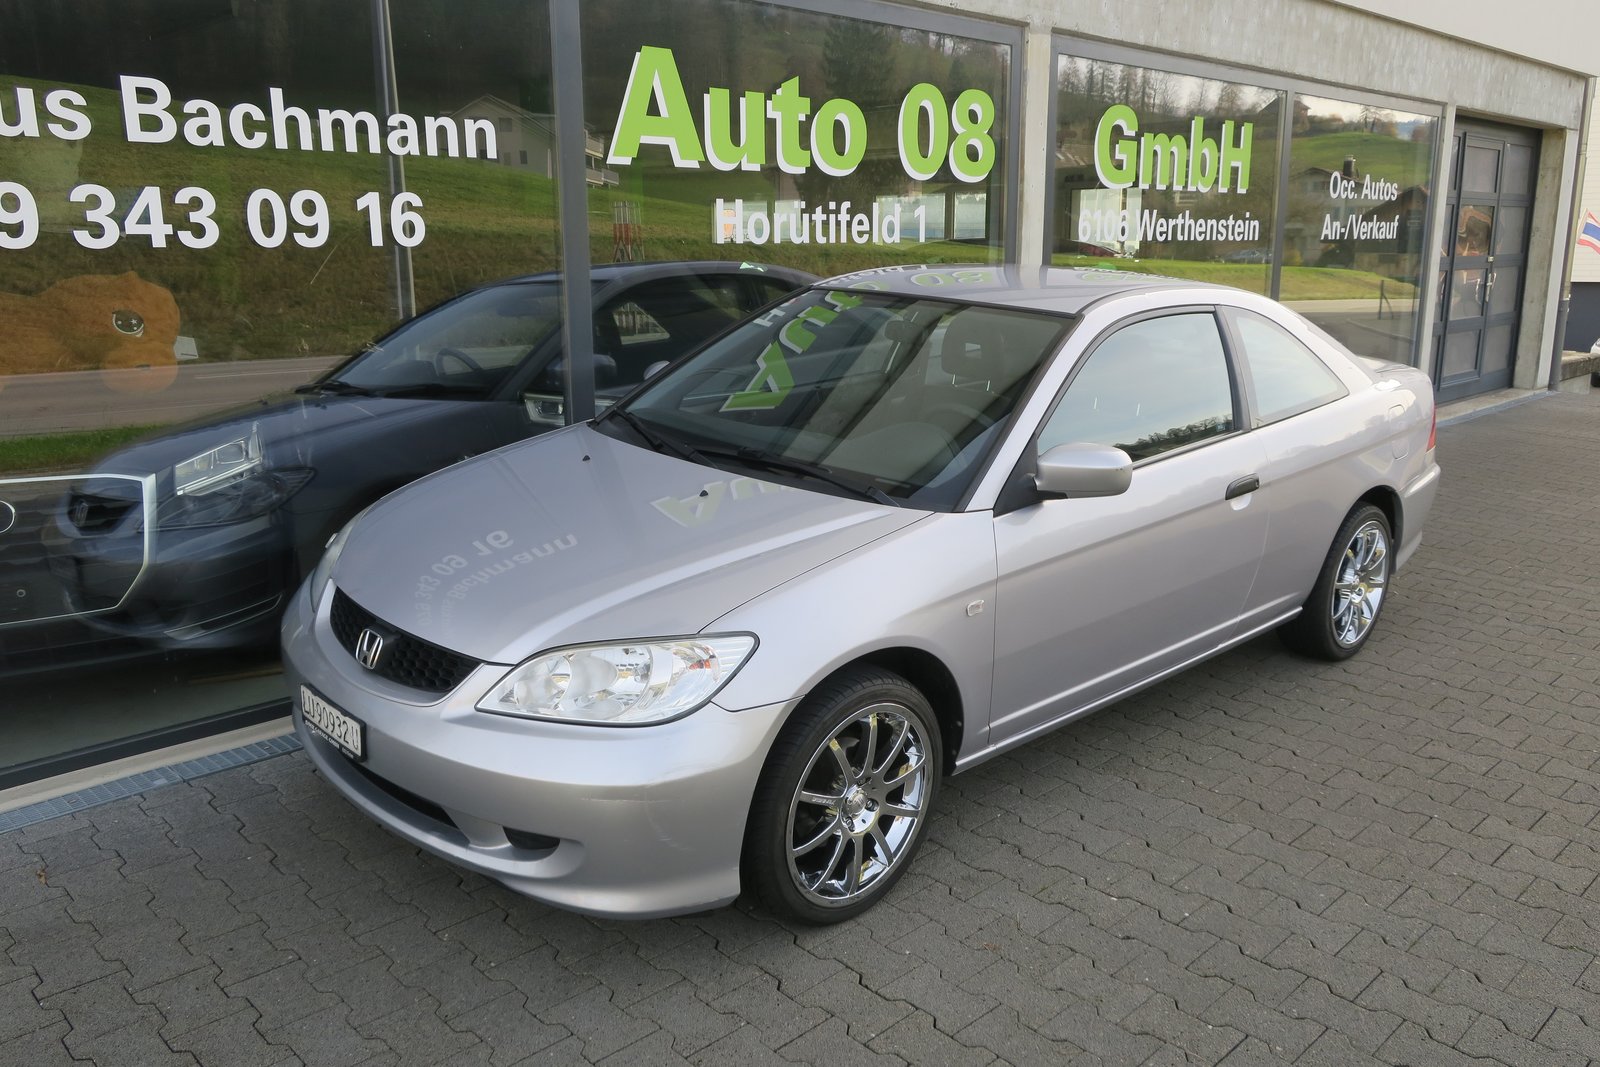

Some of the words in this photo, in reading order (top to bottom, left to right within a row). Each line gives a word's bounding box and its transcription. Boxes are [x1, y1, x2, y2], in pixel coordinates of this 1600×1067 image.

[119, 75, 498, 160] Bachmann
[606, 46, 868, 176] Auto
[898, 83, 995, 183] 08
[1094, 104, 1254, 194] GmbH
[1329, 170, 1358, 199] Occ.
[1360, 173, 1398, 201] Autos
[69, 184, 220, 250] 343
[246, 188, 330, 249] 09
[356, 191, 426, 248] 16
[715, 198, 901, 245] Horütifeld
[913, 204, 926, 243] 1
[1078, 209, 1129, 242] 6106
[1135, 208, 1260, 242] Werthenstein
[1320, 213, 1400, 240] An-/Verkauf
